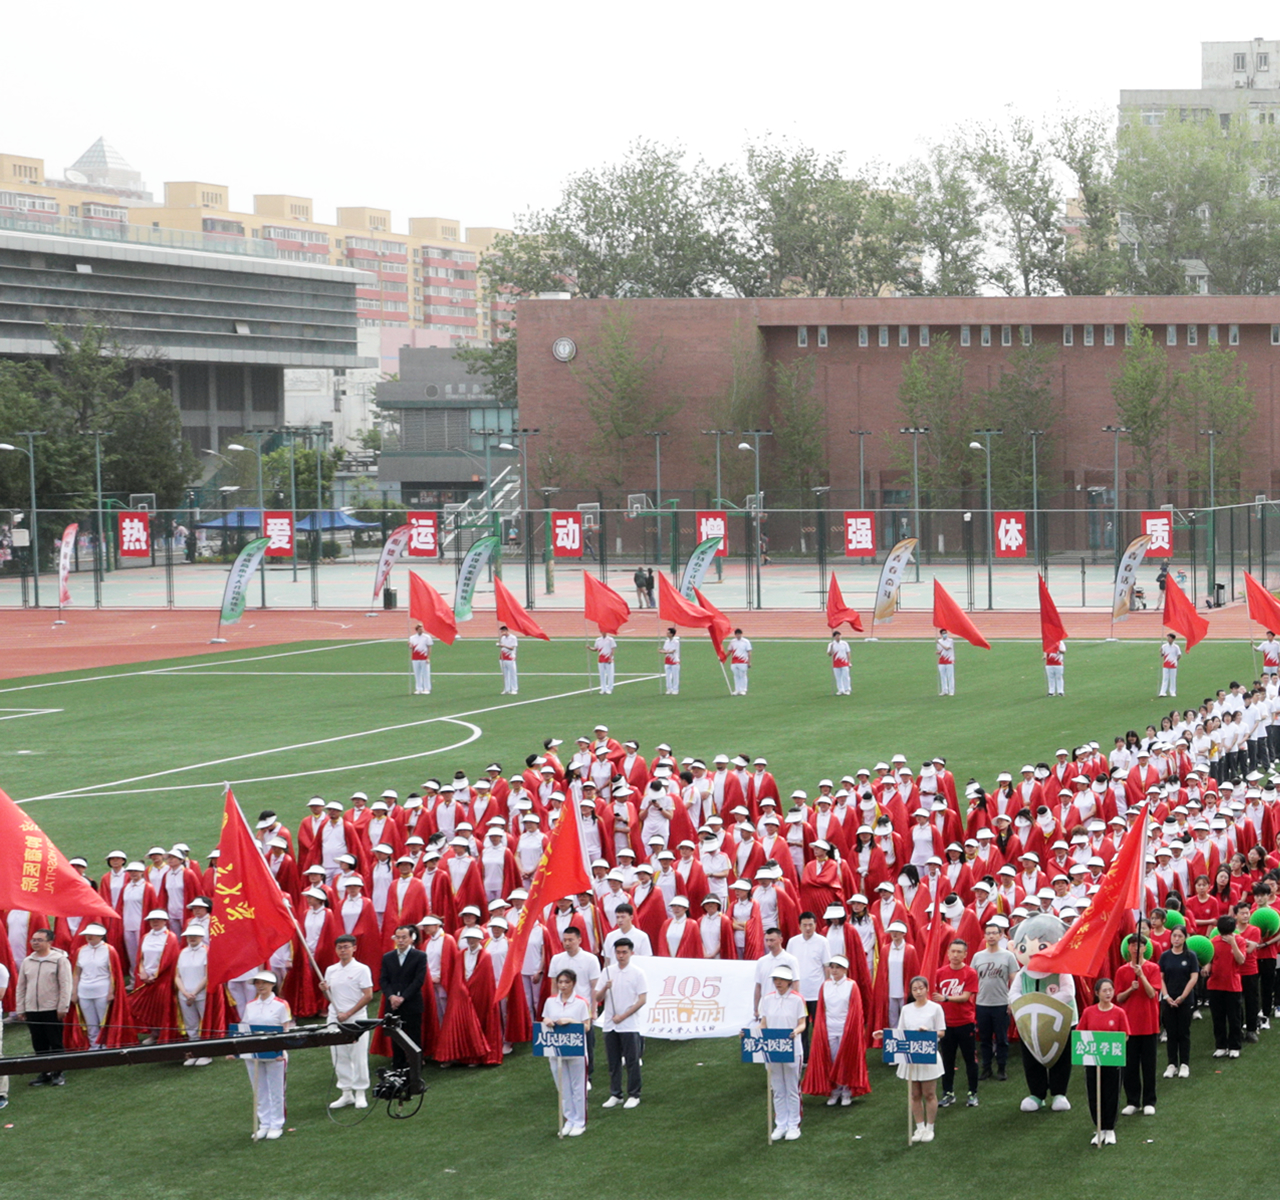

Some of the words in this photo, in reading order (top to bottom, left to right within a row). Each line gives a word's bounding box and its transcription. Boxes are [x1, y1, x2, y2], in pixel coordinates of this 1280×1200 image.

[123, 519, 148, 549] 热
[266, 518, 292, 549] 爱
[410, 518, 435, 550] 运
[556, 518, 580, 549] 动
[700, 518, 725, 550] 增
[847, 518, 873, 549] 强
[998, 519, 1024, 550] 体
[1145, 518, 1170, 550] 质
[659, 975, 723, 999] 105
[534, 1032, 584, 1048] 人民医院
[742, 1037, 793, 1053] 第六医院
[884, 1037, 936, 1055] 第三医院
[1075, 1041, 1122, 1056] 公卫学院
